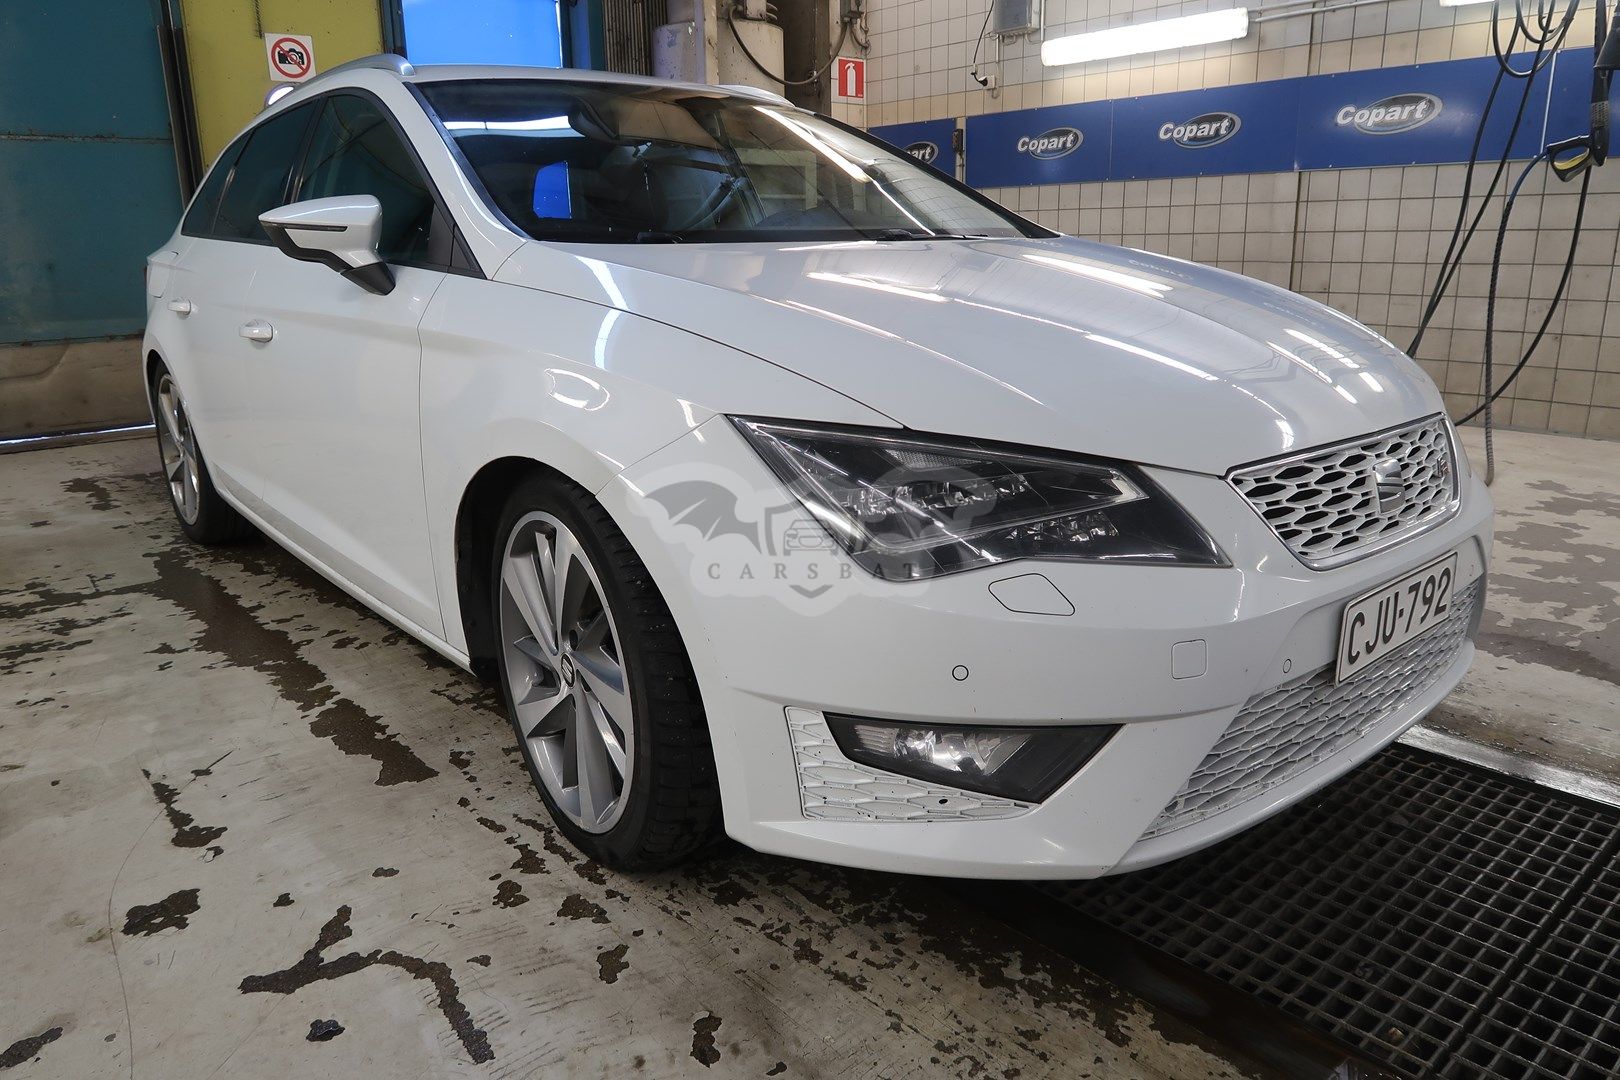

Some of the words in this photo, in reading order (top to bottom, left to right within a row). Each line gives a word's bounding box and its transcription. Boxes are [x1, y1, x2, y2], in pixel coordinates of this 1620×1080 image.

[1337, 98, 1430, 128] Copart
[1018, 132, 1076, 153] Copart
[1159, 117, 1230, 141] Copart
[1348, 567, 1451, 665] CJU-792
